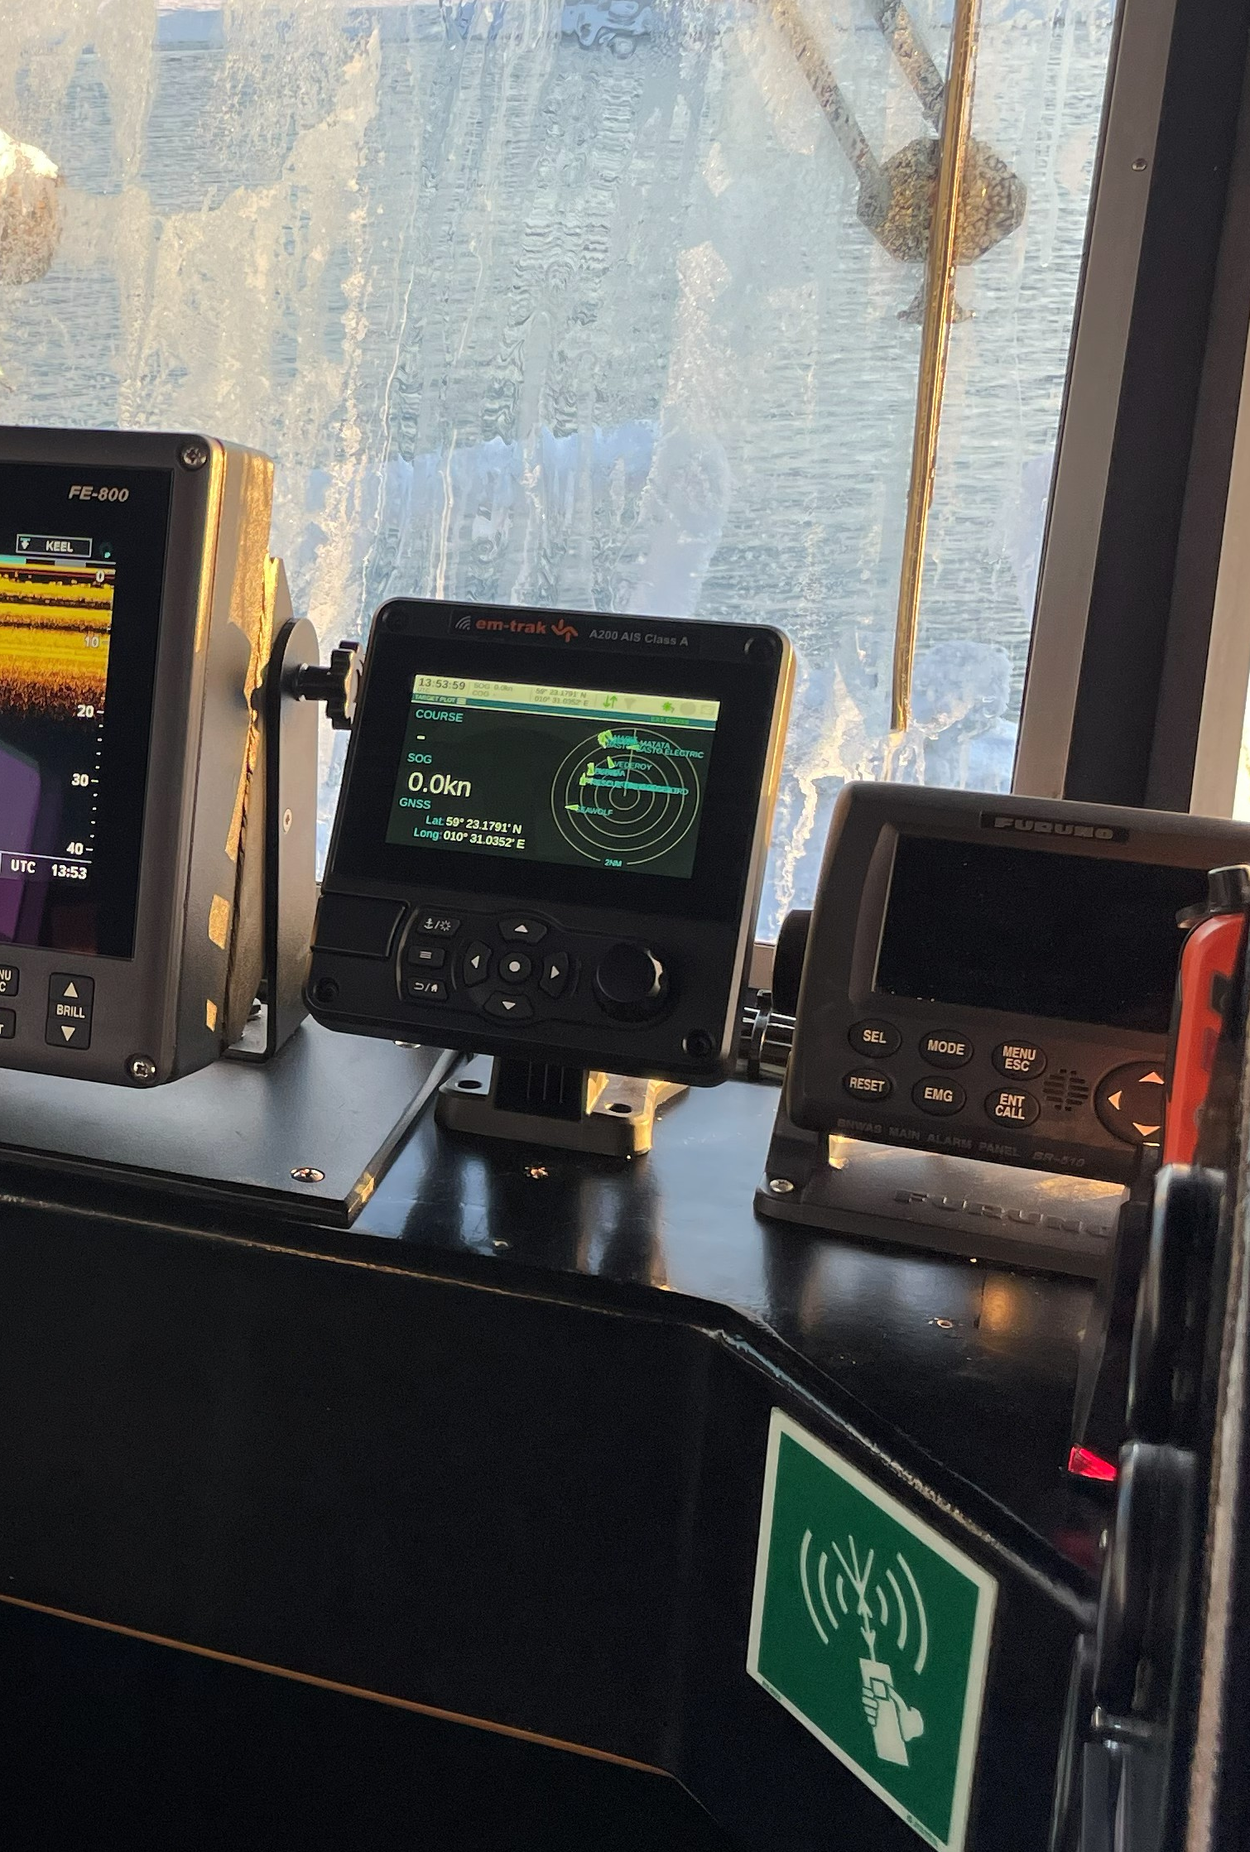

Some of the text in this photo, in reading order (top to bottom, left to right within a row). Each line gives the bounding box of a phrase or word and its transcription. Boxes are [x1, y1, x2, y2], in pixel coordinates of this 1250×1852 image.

[68, 485, 129, 502] FE-800
[46, 541, 73, 552] KEEL
[96, 570, 104, 582] 0
[476, 619, 689, 646] em-trak A200 AIS Class A
[84, 636, 99, 647] 10
[418, 678, 466, 690] 13:53:59
[76, 704, 94, 718] 20
[415, 709, 464, 723] COURSE
[407, 752, 432, 764] SOG
[665, 748, 704, 759] ELECTRIC
[71, 773, 89, 787] 30
[408, 771, 472, 797] 0.0kn
[399, 797, 431, 810] GNSS
[512, 824, 522, 835] N
[993, 817, 1113, 840] FURUNO
[66, 842, 84, 855] 40
[516, 838, 526, 849] E
[10, 859, 88, 880] UTC 13:53
[604, 859, 623, 868] 2NM
[56, 1004, 85, 1019] BRILL
[863, 1029, 887, 1044] SEL
[927, 1039, 965, 1056] MODE
[1002, 1045, 1036, 1061] MENU
[1004, 1059, 1029, 1072] ESC
[850, 1076, 885, 1092] RESET
[924, 1087, 953, 1102] EMG
[1000, 1093, 1025, 1108] ENT
[995, 1105, 1025, 1120] CALL
[888, 1127, 921, 1141] MAIN
[927, 1133, 973, 1149] ALARM
[978, 1141, 1021, 1157] PANEL
